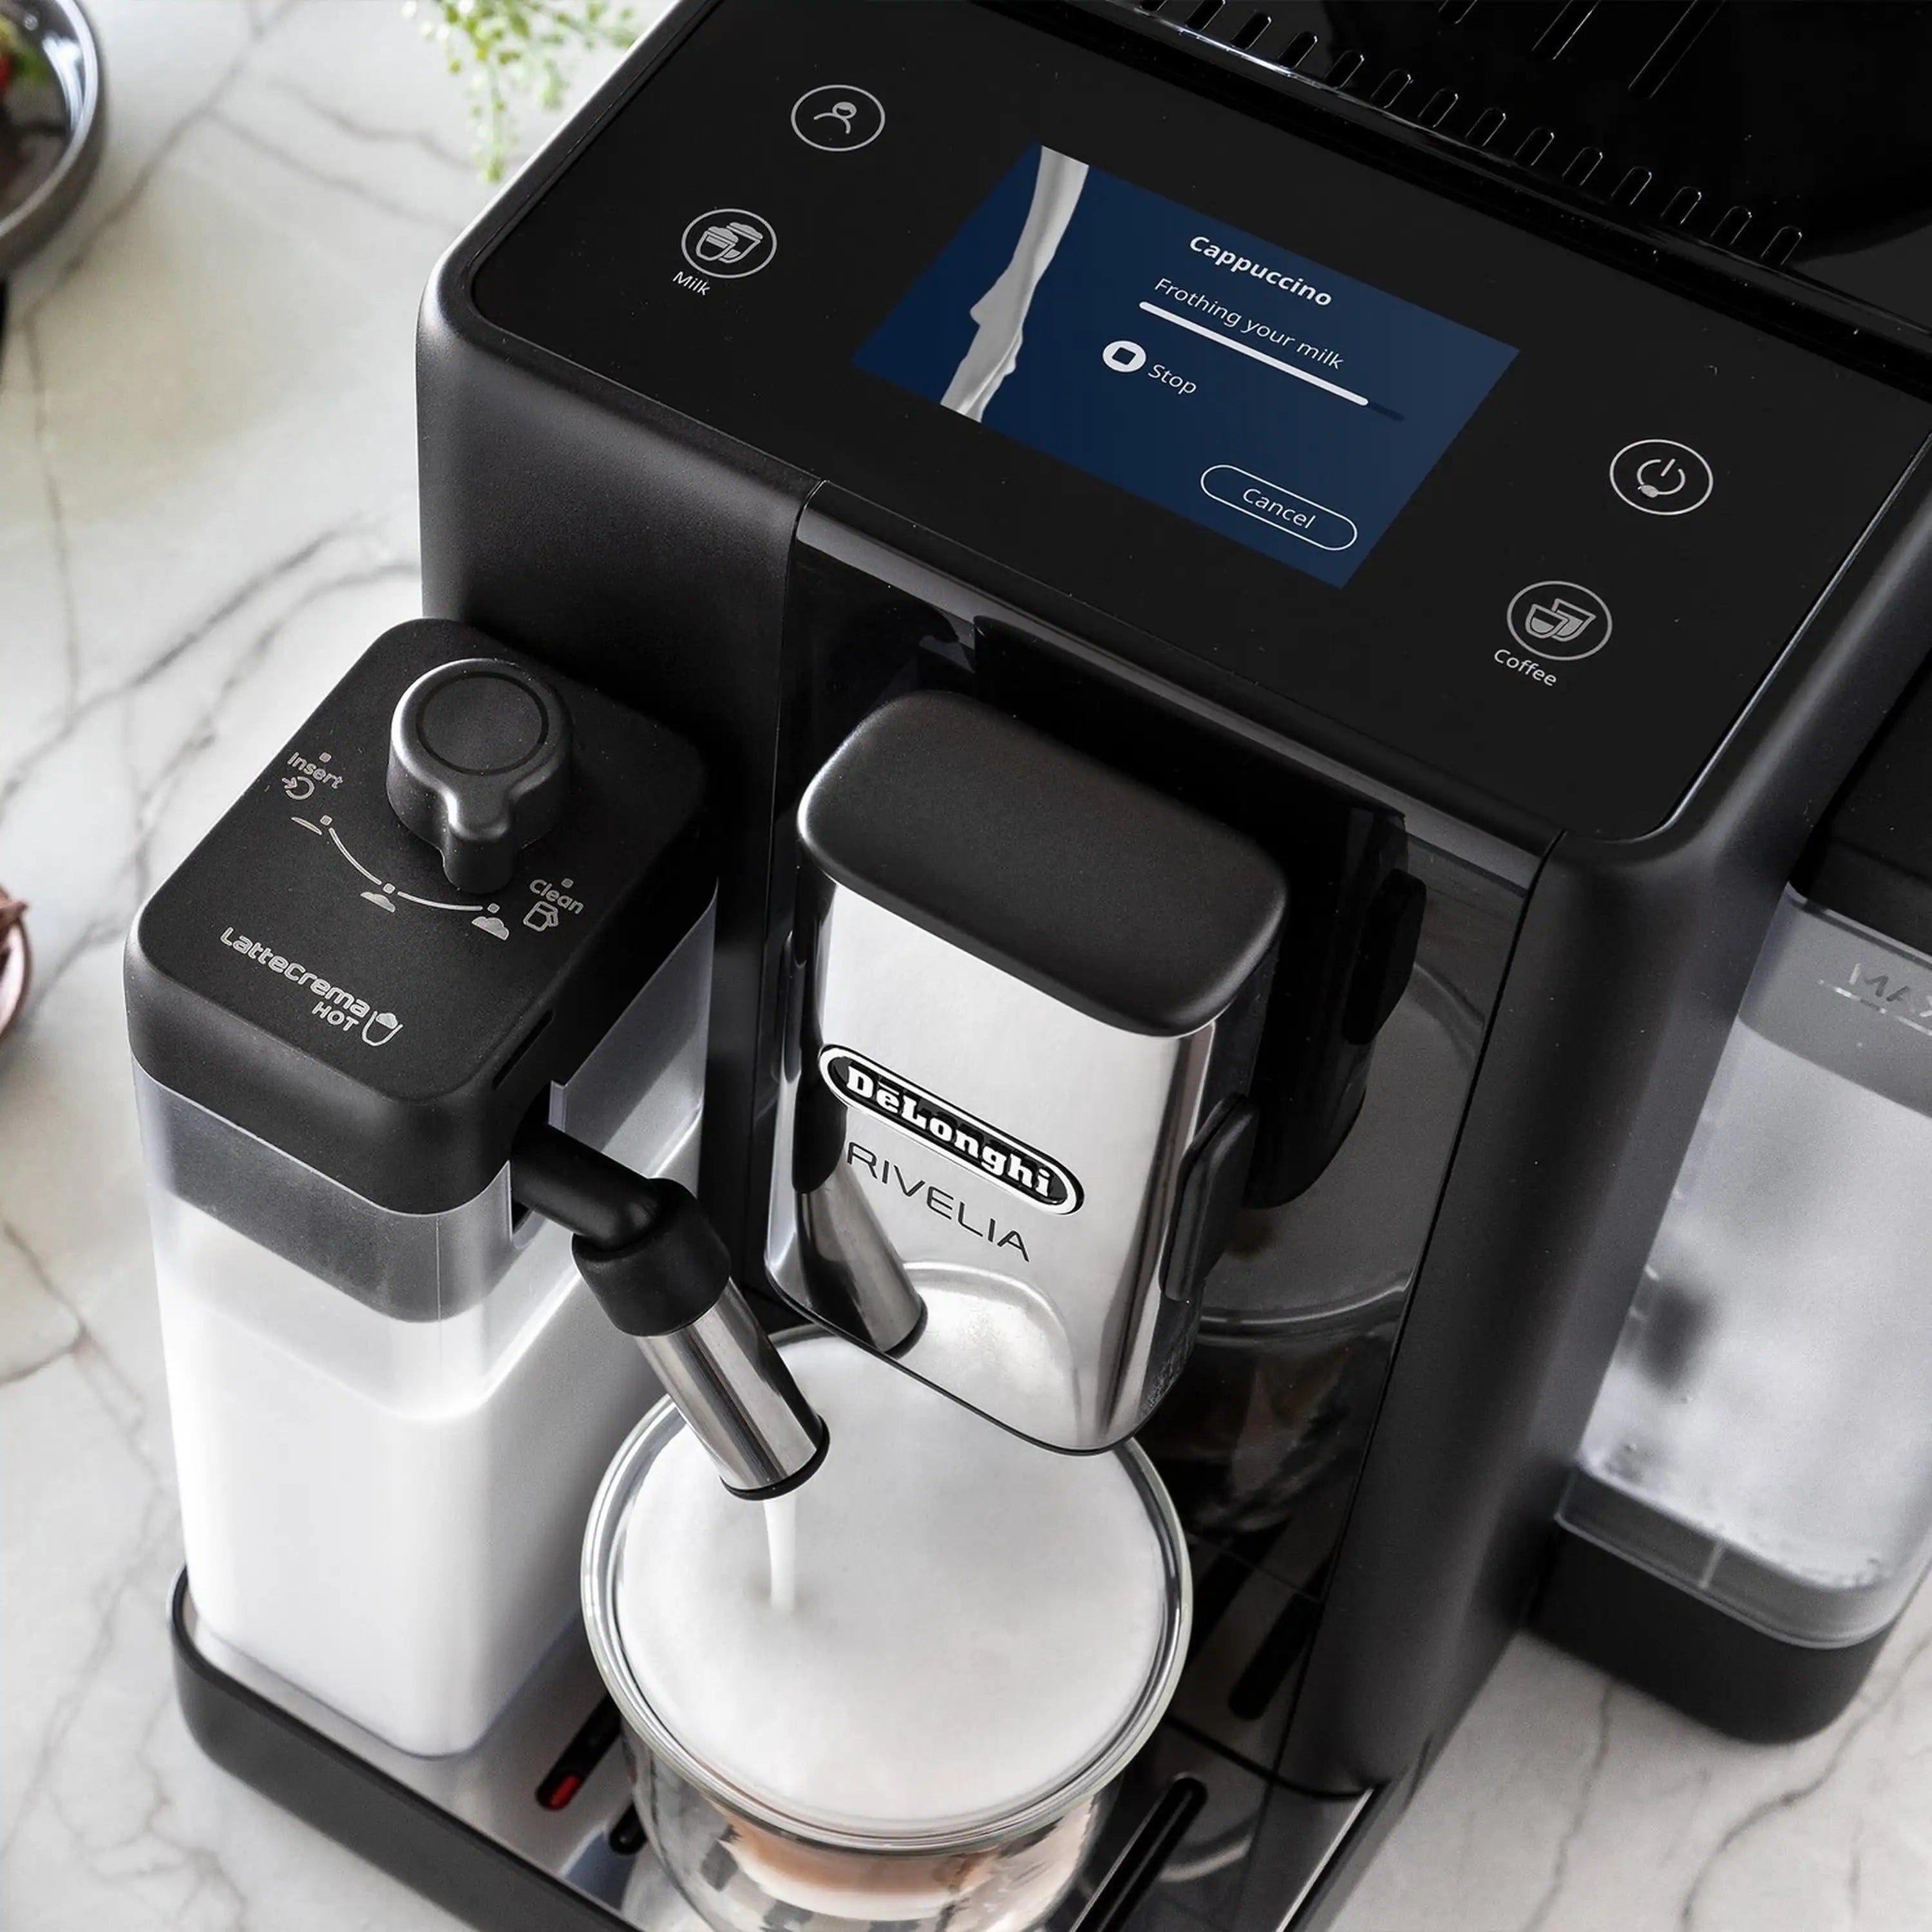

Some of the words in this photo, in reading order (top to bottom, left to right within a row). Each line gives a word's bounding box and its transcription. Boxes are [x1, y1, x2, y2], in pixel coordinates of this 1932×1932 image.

[672, 272, 710, 295] Milk
[1189, 236, 1332, 307] Cappuccino
[1155, 278, 1242, 327] Frothing
[1241, 317, 1295, 348] your
[1297, 339, 1345, 369] milk
[1148, 364, 1197, 395] Stop
[1243, 488, 1316, 529] Cancel
[1494, 649, 1557, 686] Coffee
[287, 752, 343, 789] Insert
[529, 878, 583, 914] Clean
[312, 1001, 359, 1032] HOT
[847, 1142, 1030, 1263] RIVELIA
